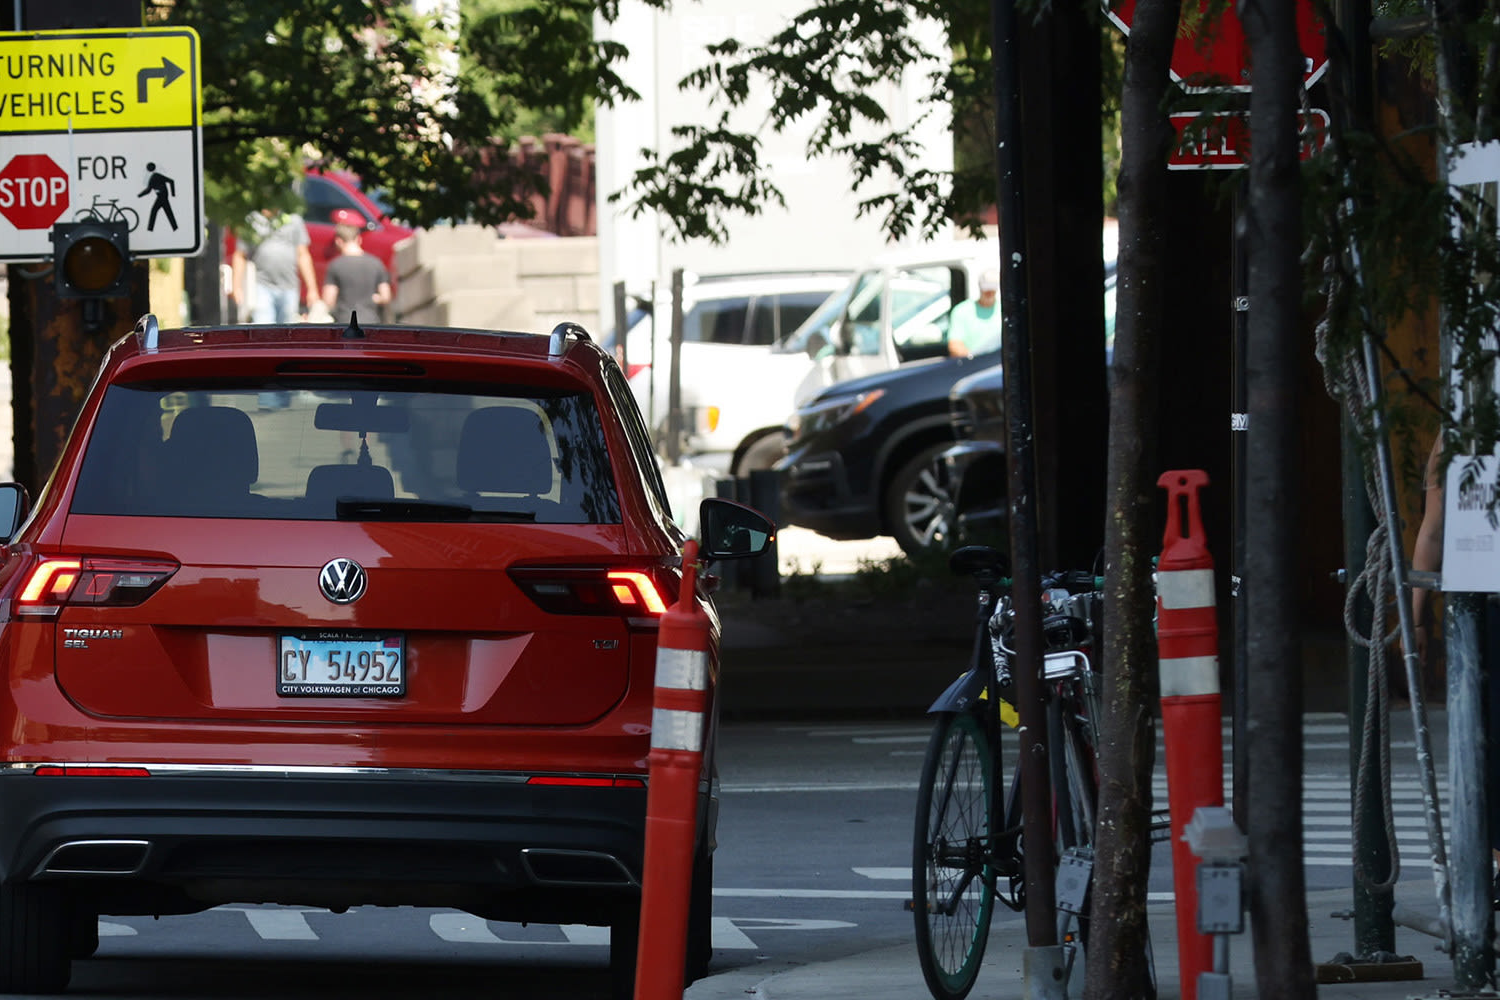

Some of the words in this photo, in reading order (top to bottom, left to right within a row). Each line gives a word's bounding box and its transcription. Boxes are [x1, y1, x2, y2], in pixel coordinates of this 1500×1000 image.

[77, 155, 128, 181] FOR
[64, 628, 124, 639] TIGUAN
[64, 639, 89, 649] SEL
[283, 650, 311, 681] CY
[328, 650, 400, 682] 54952
[281, 685, 299, 693] CITY
[300, 685, 351, 694] VOLKSWAGEN
[353, 685, 361, 693] of
[362, 685, 400, 694] CHICAGO
